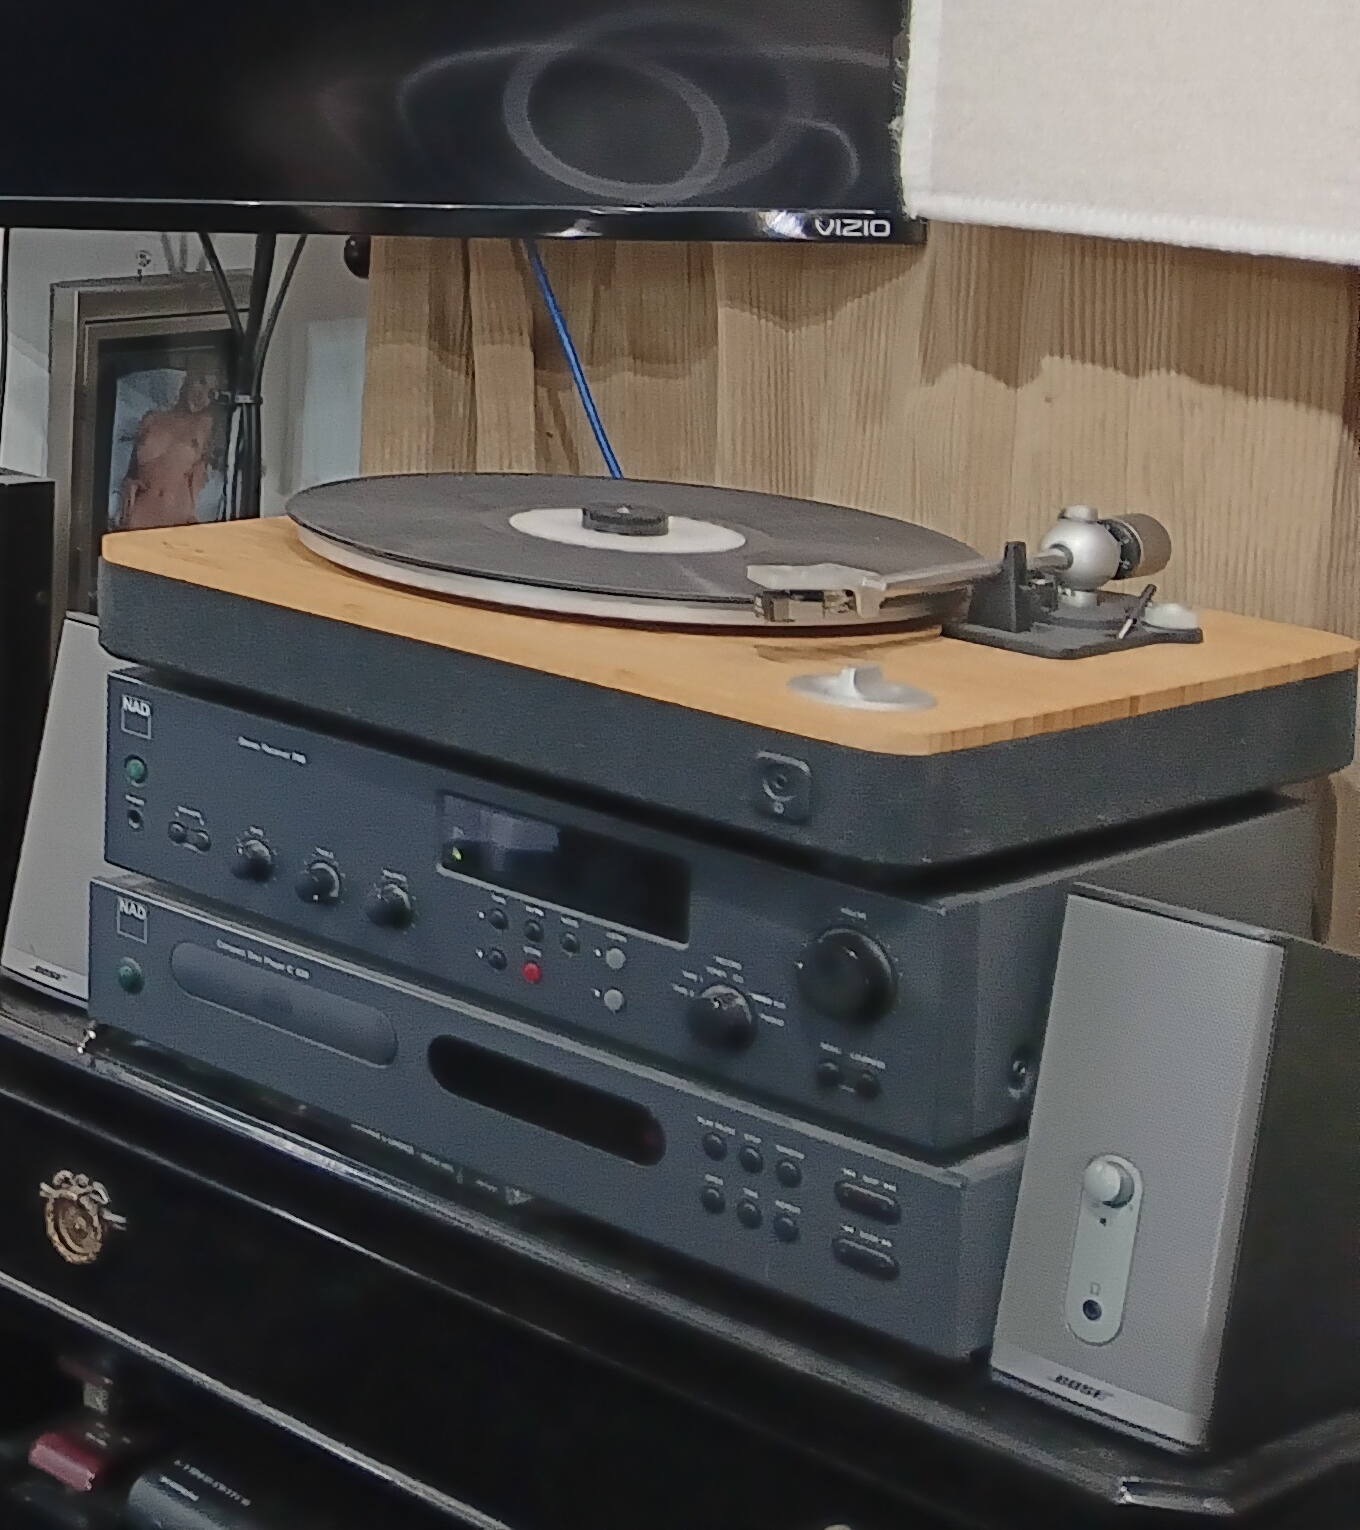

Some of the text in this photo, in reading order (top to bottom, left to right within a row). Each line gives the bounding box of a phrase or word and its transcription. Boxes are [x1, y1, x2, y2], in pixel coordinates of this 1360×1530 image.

[814, 219, 891, 238] VIZIO
[122, 693, 151, 717] NAD
[118, 897, 147, 920] NAD
